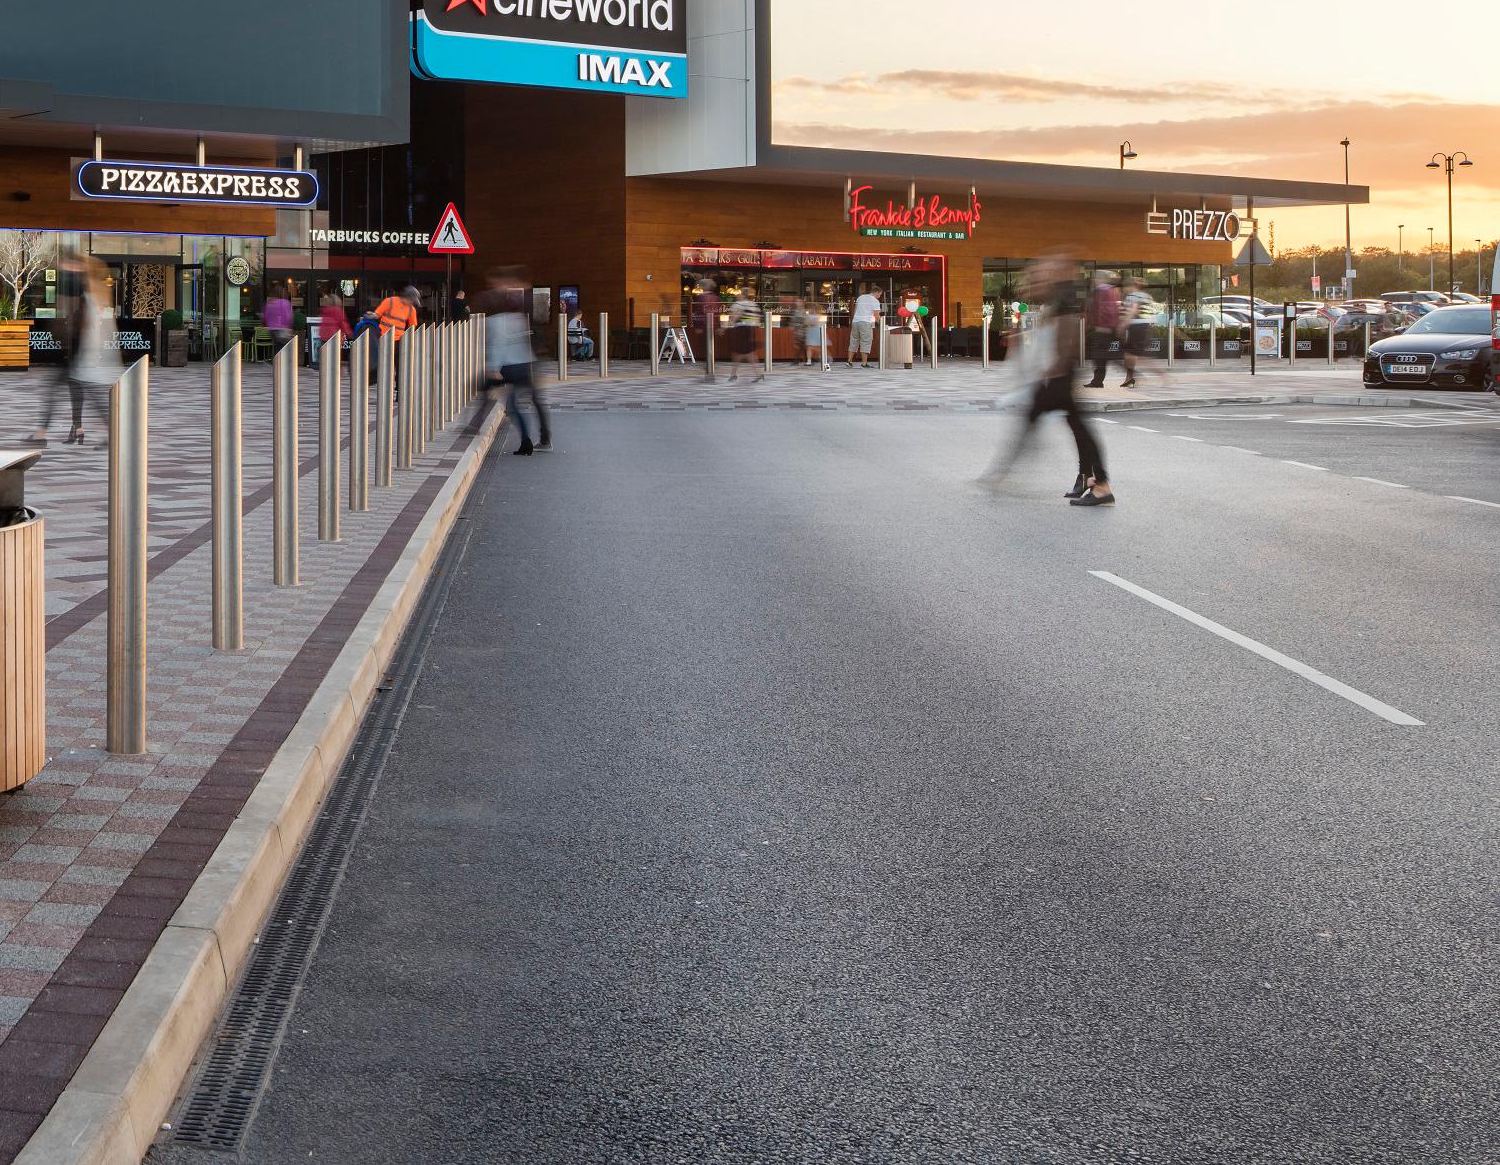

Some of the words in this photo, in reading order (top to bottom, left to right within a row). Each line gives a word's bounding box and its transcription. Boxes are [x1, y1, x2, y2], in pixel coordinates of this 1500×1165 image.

[579, 53, 673, 88] IMAX
[101, 168, 300, 198] PIZZAEXPRESS
[850, 185, 911, 232] Frankie
[914, 197, 926, 228] &
[928, 194, 982, 238] Benny's
[1173, 208, 1241, 242] PREZZO
[309, 229, 380, 243] TARBUCKS
[382, 231, 430, 245] COFFEE
[880, 229, 893, 237] YORK
[917, 231, 946, 239] RESTAURANT
[29, 331, 53, 341] IZZA
[112, 331, 143, 341] PIZZA
[29, 341, 62, 350] PRESS
[104, 341, 151, 350] EXPRESS
